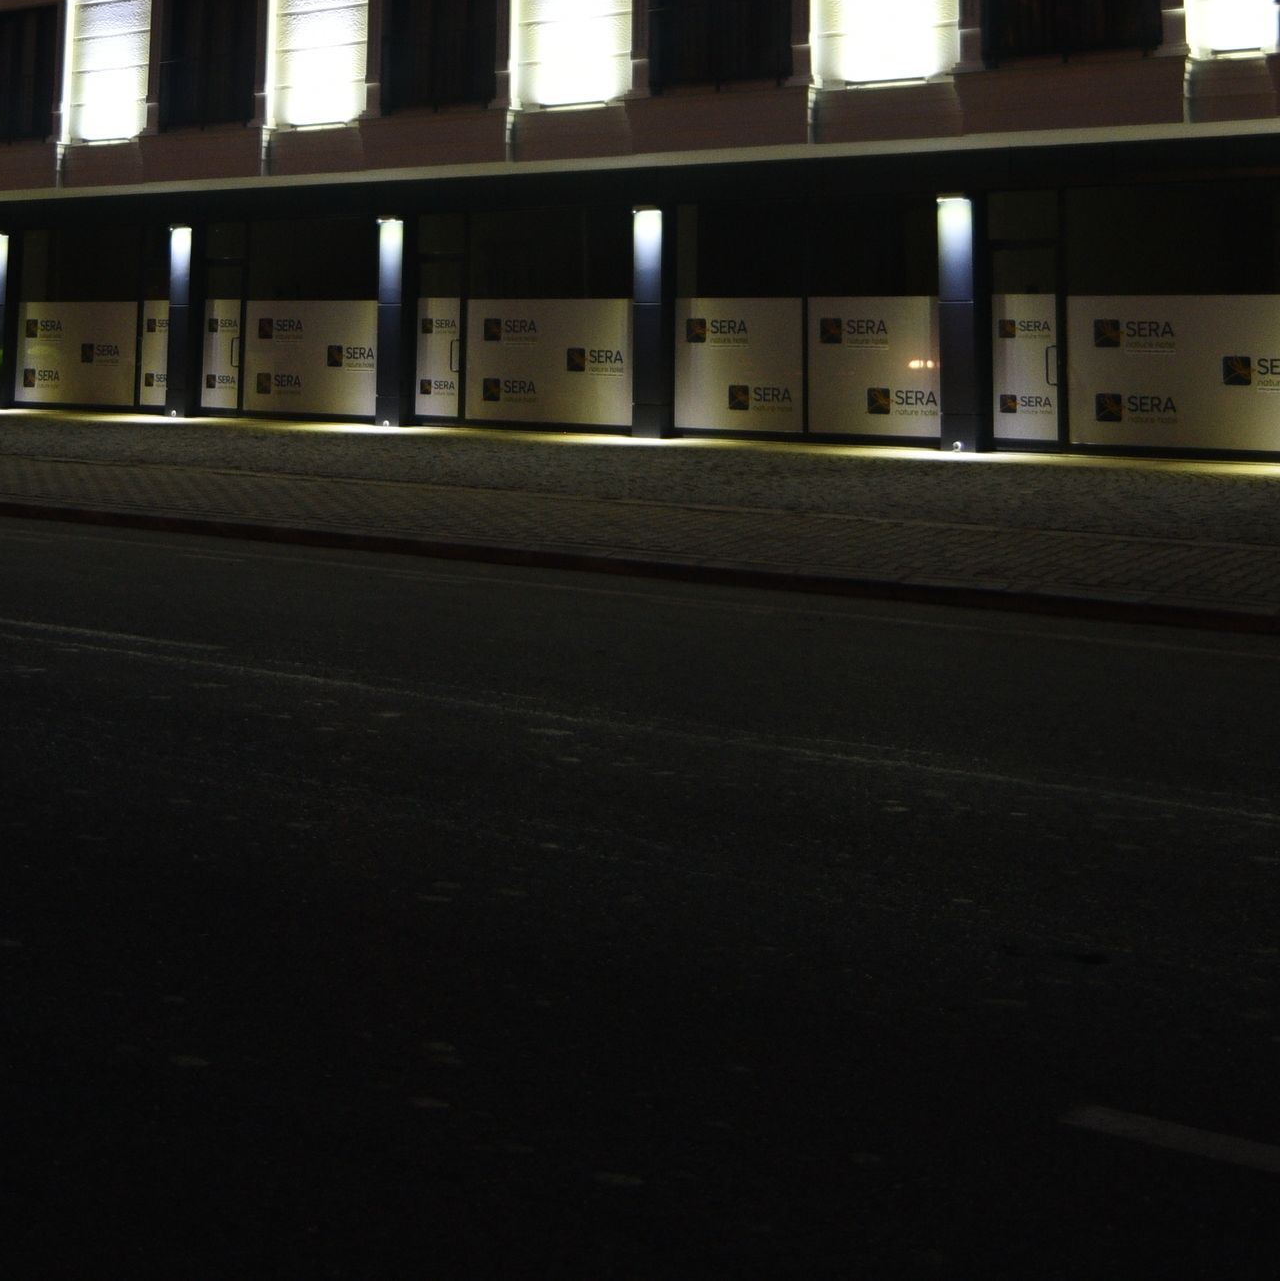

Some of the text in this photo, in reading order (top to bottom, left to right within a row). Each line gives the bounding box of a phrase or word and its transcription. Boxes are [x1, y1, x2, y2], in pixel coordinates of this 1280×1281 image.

[40, 320, 63, 332] SERA
[276, 319, 304, 332] SERA
[435, 319, 456, 329] SERA
[505, 319, 537, 333] SERA
[710, 320, 748, 335] SERA
[847, 319, 888, 335] SERA
[1019, 320, 1051, 332] SERA
[1125, 321, 1174, 338] SERA
[95, 344, 120, 356] SERA
[346, 347, 375, 360] SERA
[589, 349, 624, 364] SERA
[38, 370, 60, 381] SERA
[218, 375, 236, 384] SERA
[274, 375, 302, 387] SERA
[433, 380, 455, 390] SERA
[503, 380, 536, 394] SERA
[753, 387, 793, 403] SERA
[895, 390, 938, 407] SERA
[1020, 395, 1052, 408] SERA
[1127, 395, 1177, 413] SERA
